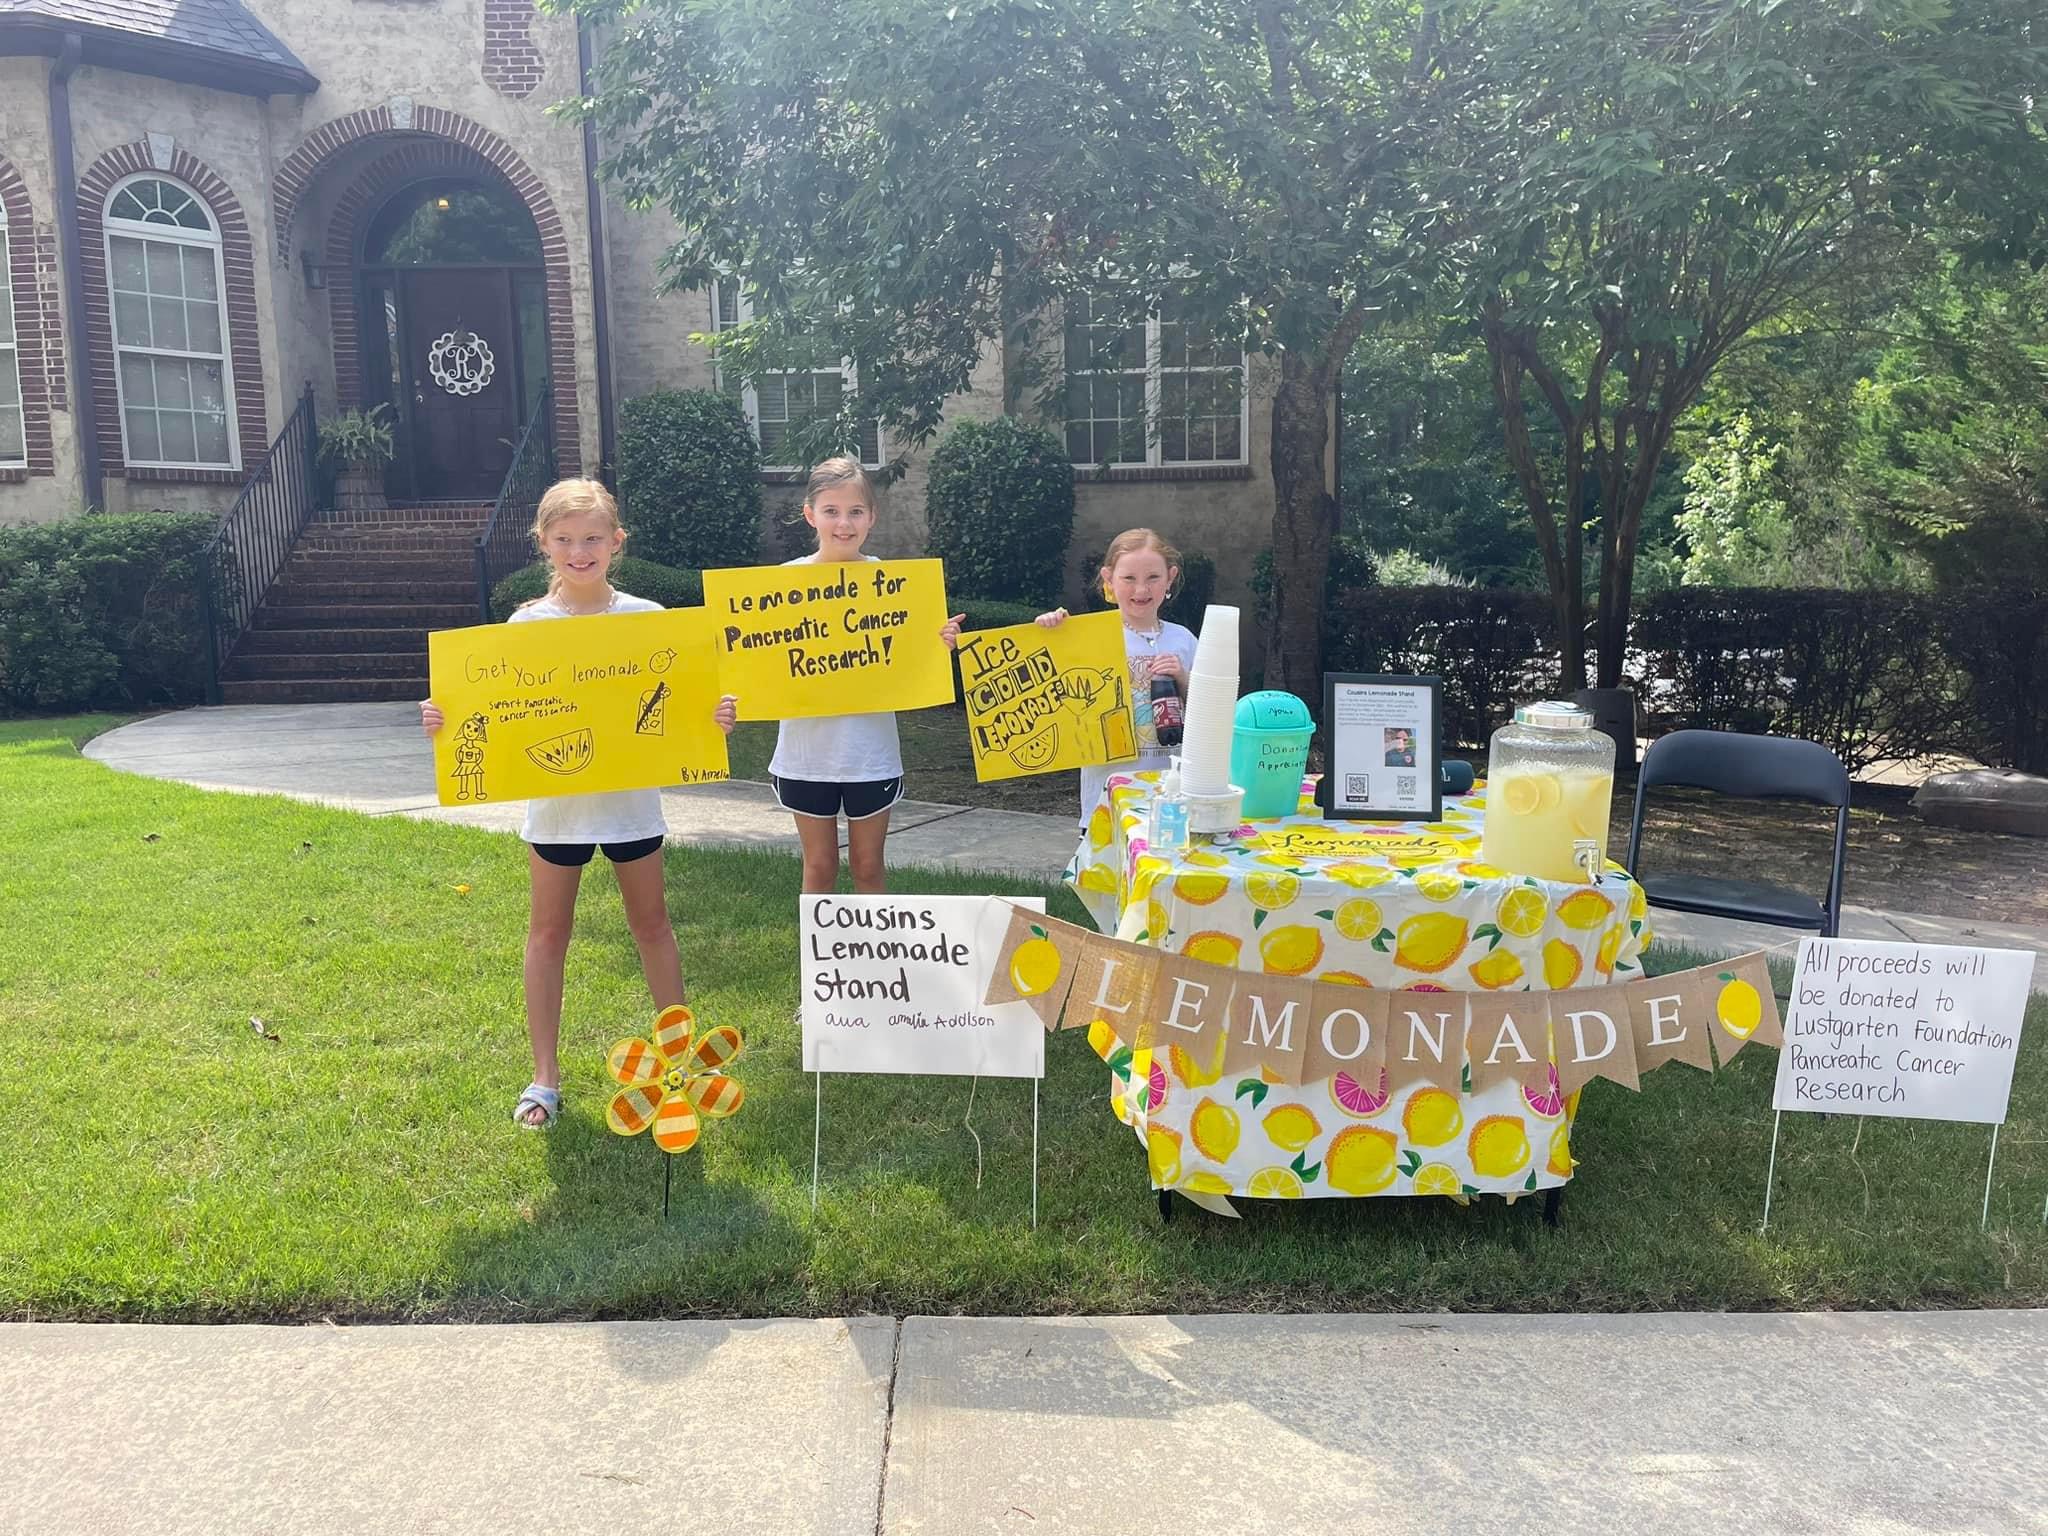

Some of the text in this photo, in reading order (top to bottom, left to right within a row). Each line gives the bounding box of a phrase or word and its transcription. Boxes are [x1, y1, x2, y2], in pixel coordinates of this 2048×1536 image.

[730, 568, 907, 614] Lemonade for
[724, 608, 908, 652] Pancreatic Cancer
[465, 654, 508, 684] Get
[513, 666, 558, 687] your
[788, 635, 893, 678] Research!
[959, 636, 1020, 681] Ice
[967, 647, 1058, 716] COLD
[813, 899, 936, 931] Cousins
[812, 933, 970, 966] Lemonade
[1803, 942, 1986, 983] All proceeds will
[814, 967, 911, 1003] Stand
[1799, 981, 1955, 1012] be donated to
[1087, 958, 1689, 1064] LEMONADE
[1795, 1010, 2013, 1050] Lustgarten Foundation
[1790, 1044, 1966, 1076] Pancreatic Cancer
[1795, 1076, 1905, 1102] Research
